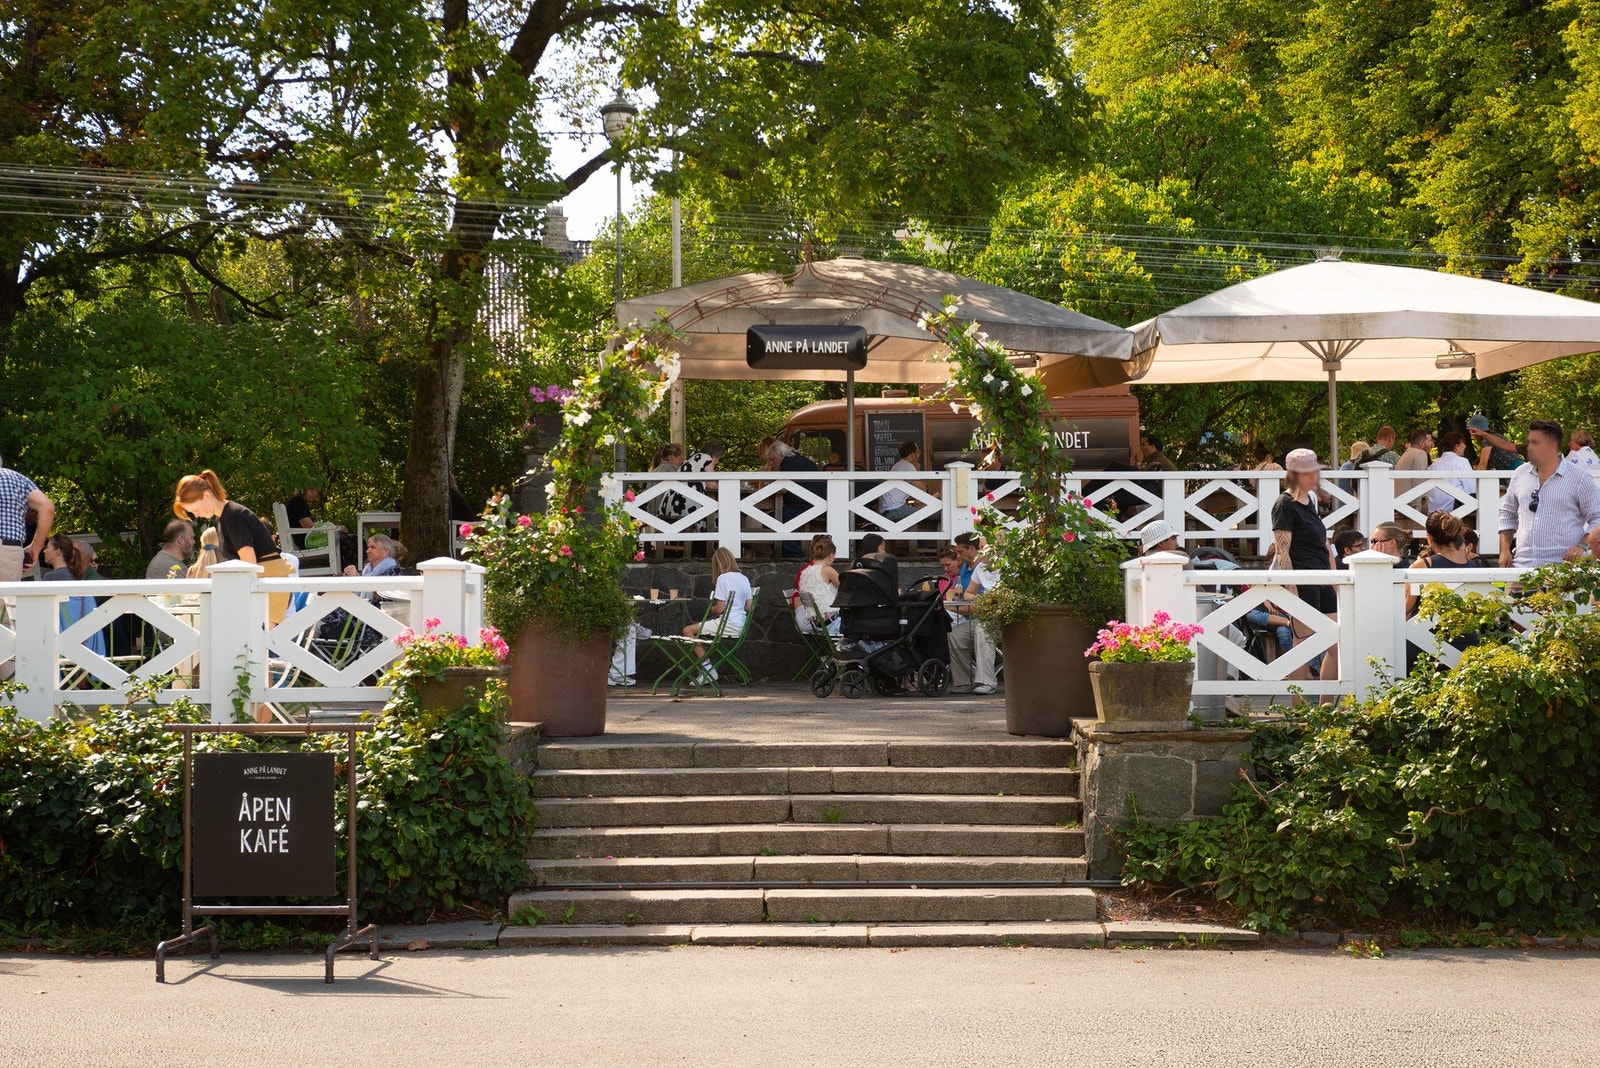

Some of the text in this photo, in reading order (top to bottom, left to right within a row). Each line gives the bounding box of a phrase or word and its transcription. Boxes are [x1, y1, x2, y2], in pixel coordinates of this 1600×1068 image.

[765, 338, 849, 353] ANNE PÅ LANDET
[1054, 431, 1091, 449] NDET
[243, 765, 287, 776] ANNE PÅ LANDET
[238, 791, 291, 822] ÅPEN
[240, 824, 289, 853] KAFÉ
